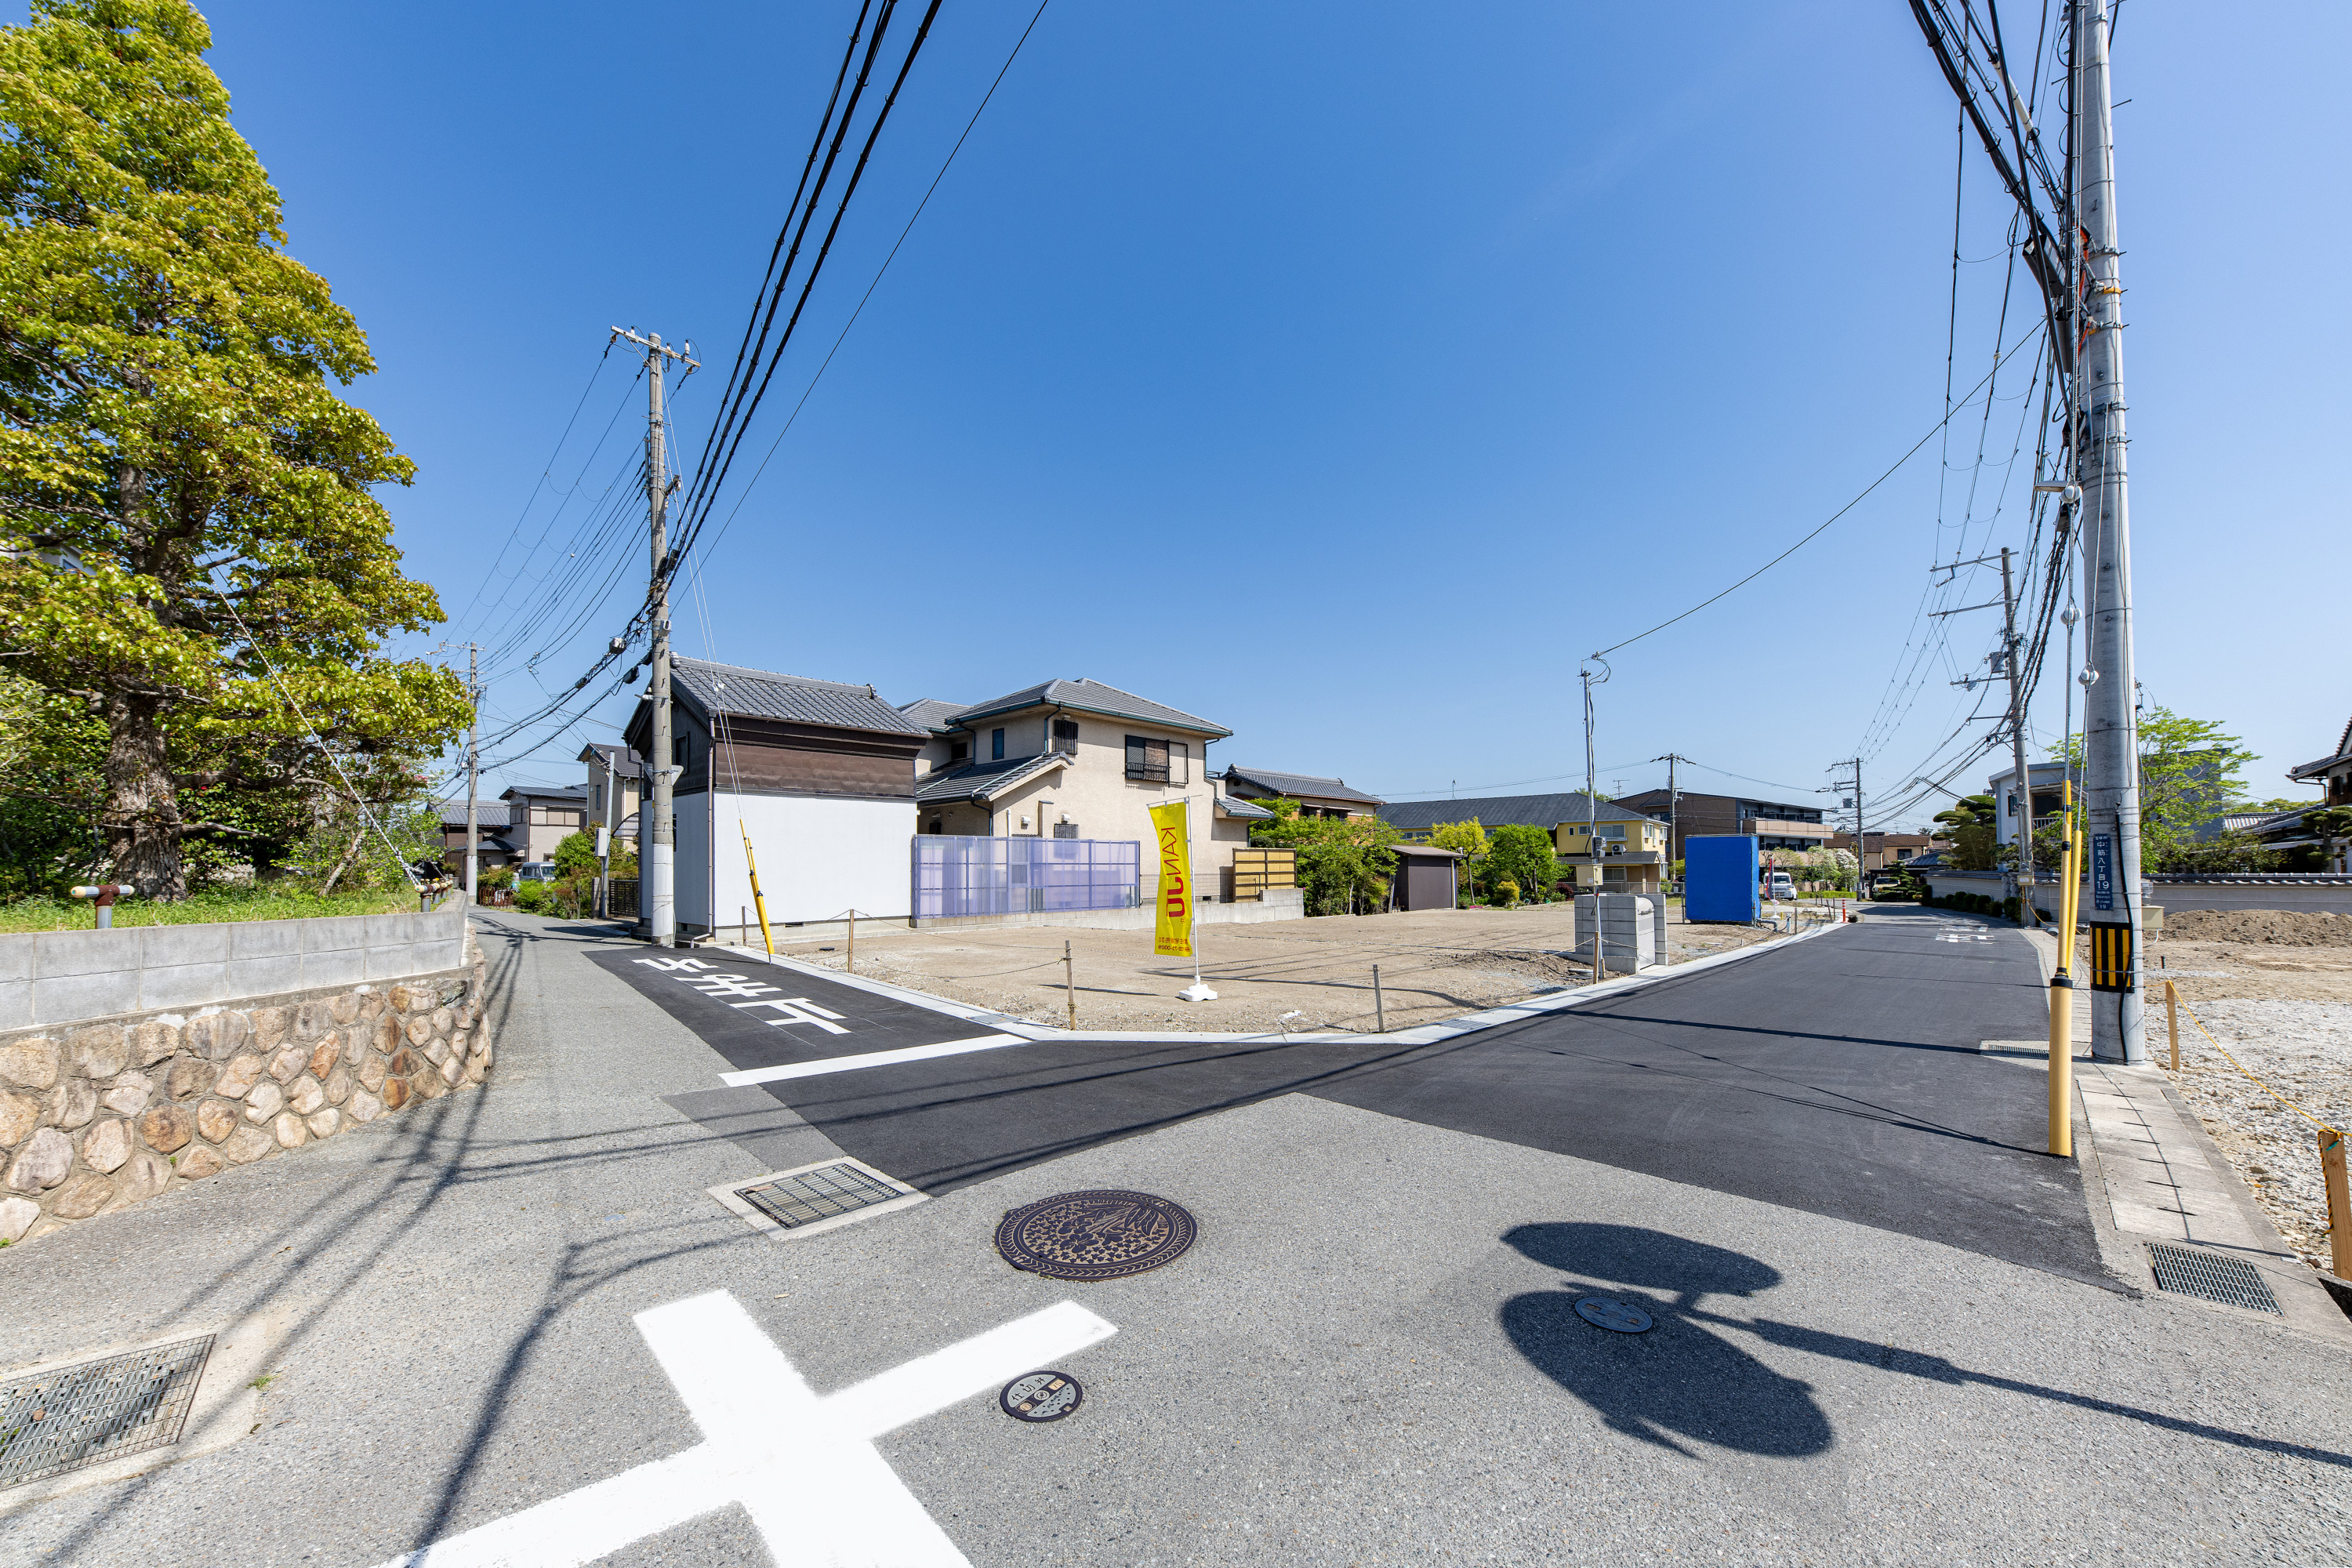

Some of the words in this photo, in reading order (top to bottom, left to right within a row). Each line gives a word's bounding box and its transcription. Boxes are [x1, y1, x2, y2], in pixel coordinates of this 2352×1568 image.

[2096, 841, 2106, 880] 中筋八丁目
[2096, 880, 2110, 889] 19
[632, 957, 853, 1035] 止まれ
[1011, 1377, 1045, 1401] 仕切弁
